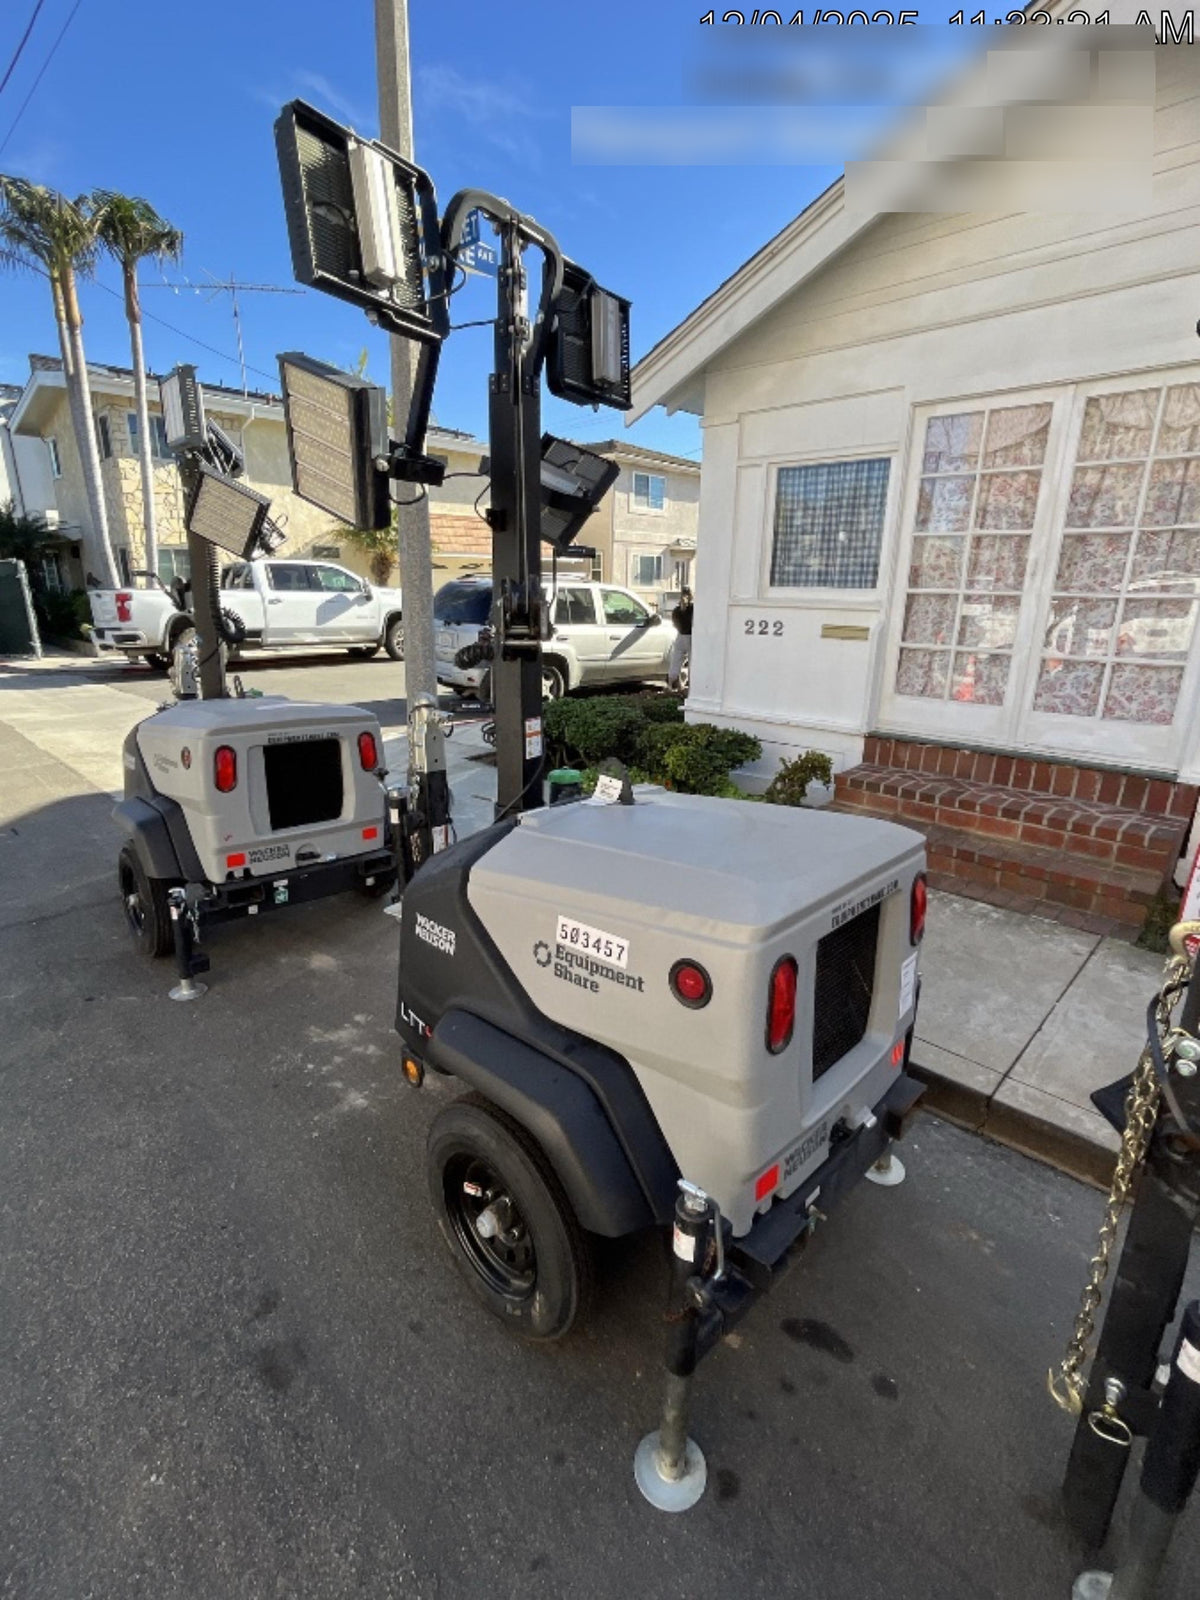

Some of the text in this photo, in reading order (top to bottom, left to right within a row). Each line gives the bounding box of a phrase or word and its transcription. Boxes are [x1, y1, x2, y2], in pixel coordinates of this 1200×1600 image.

[744, 619, 785, 637] 222
[415, 912, 457, 944] WACKER
[415, 924, 456, 956] NEUSON
[559, 923, 626, 961] 503457
[553, 962, 600, 993] Share
[555, 943, 646, 993] Equipment
